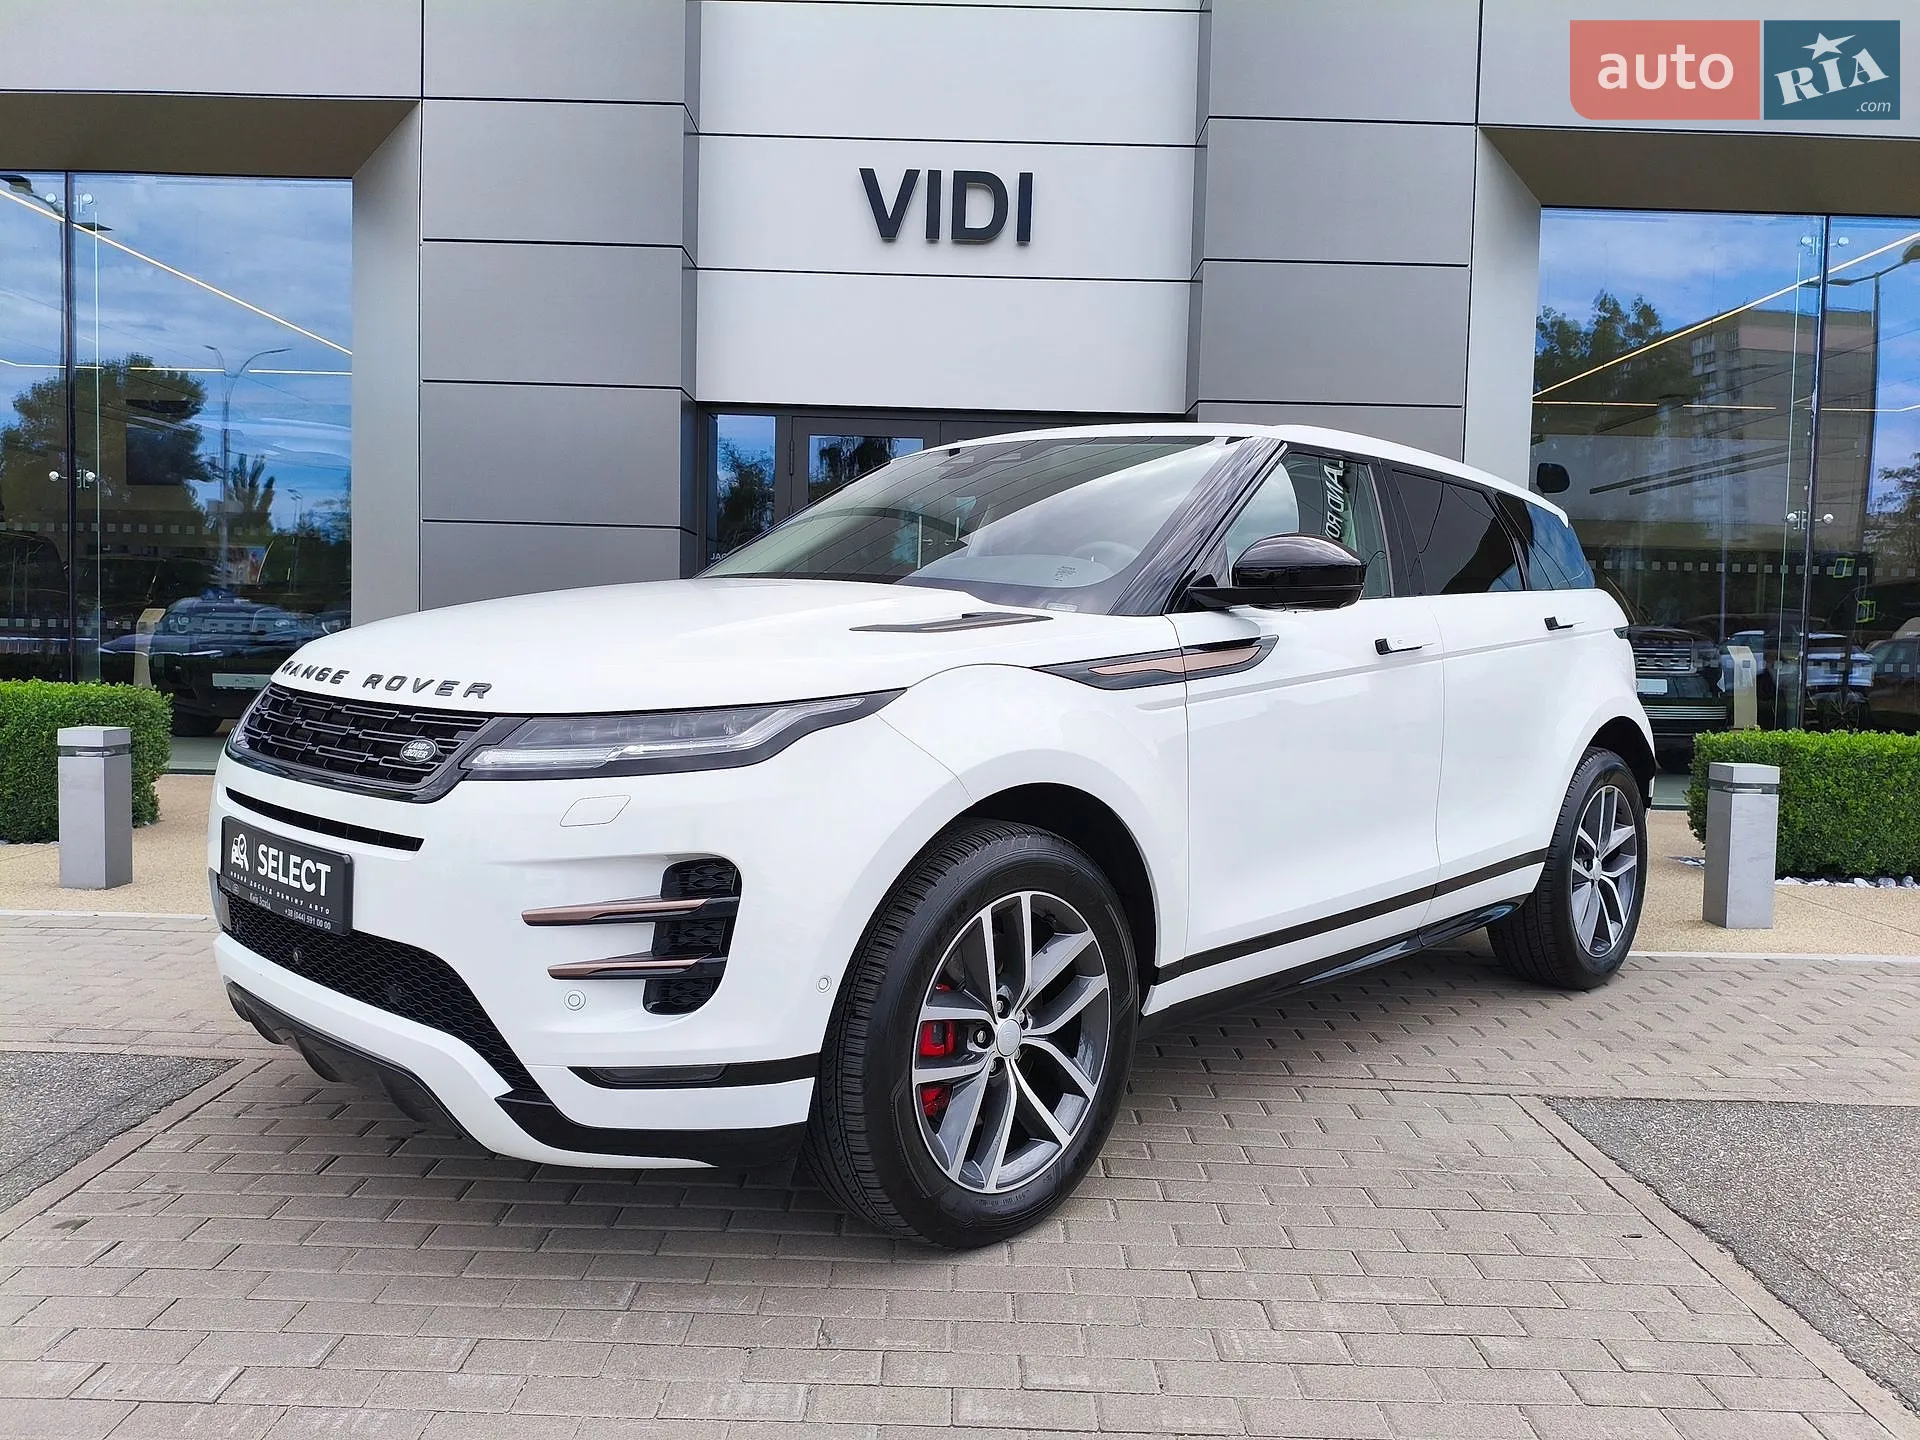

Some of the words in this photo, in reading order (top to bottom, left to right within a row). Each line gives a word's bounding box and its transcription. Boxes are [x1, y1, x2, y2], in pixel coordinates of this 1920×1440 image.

[858, 168, 1034, 245] VIDI
[281, 660, 351, 685] RANGE
[362, 673, 493, 699] ROVER
[404, 749, 429, 758] ROVER
[408, 742, 427, 750] LAND
[258, 843, 331, 897] SELECT
